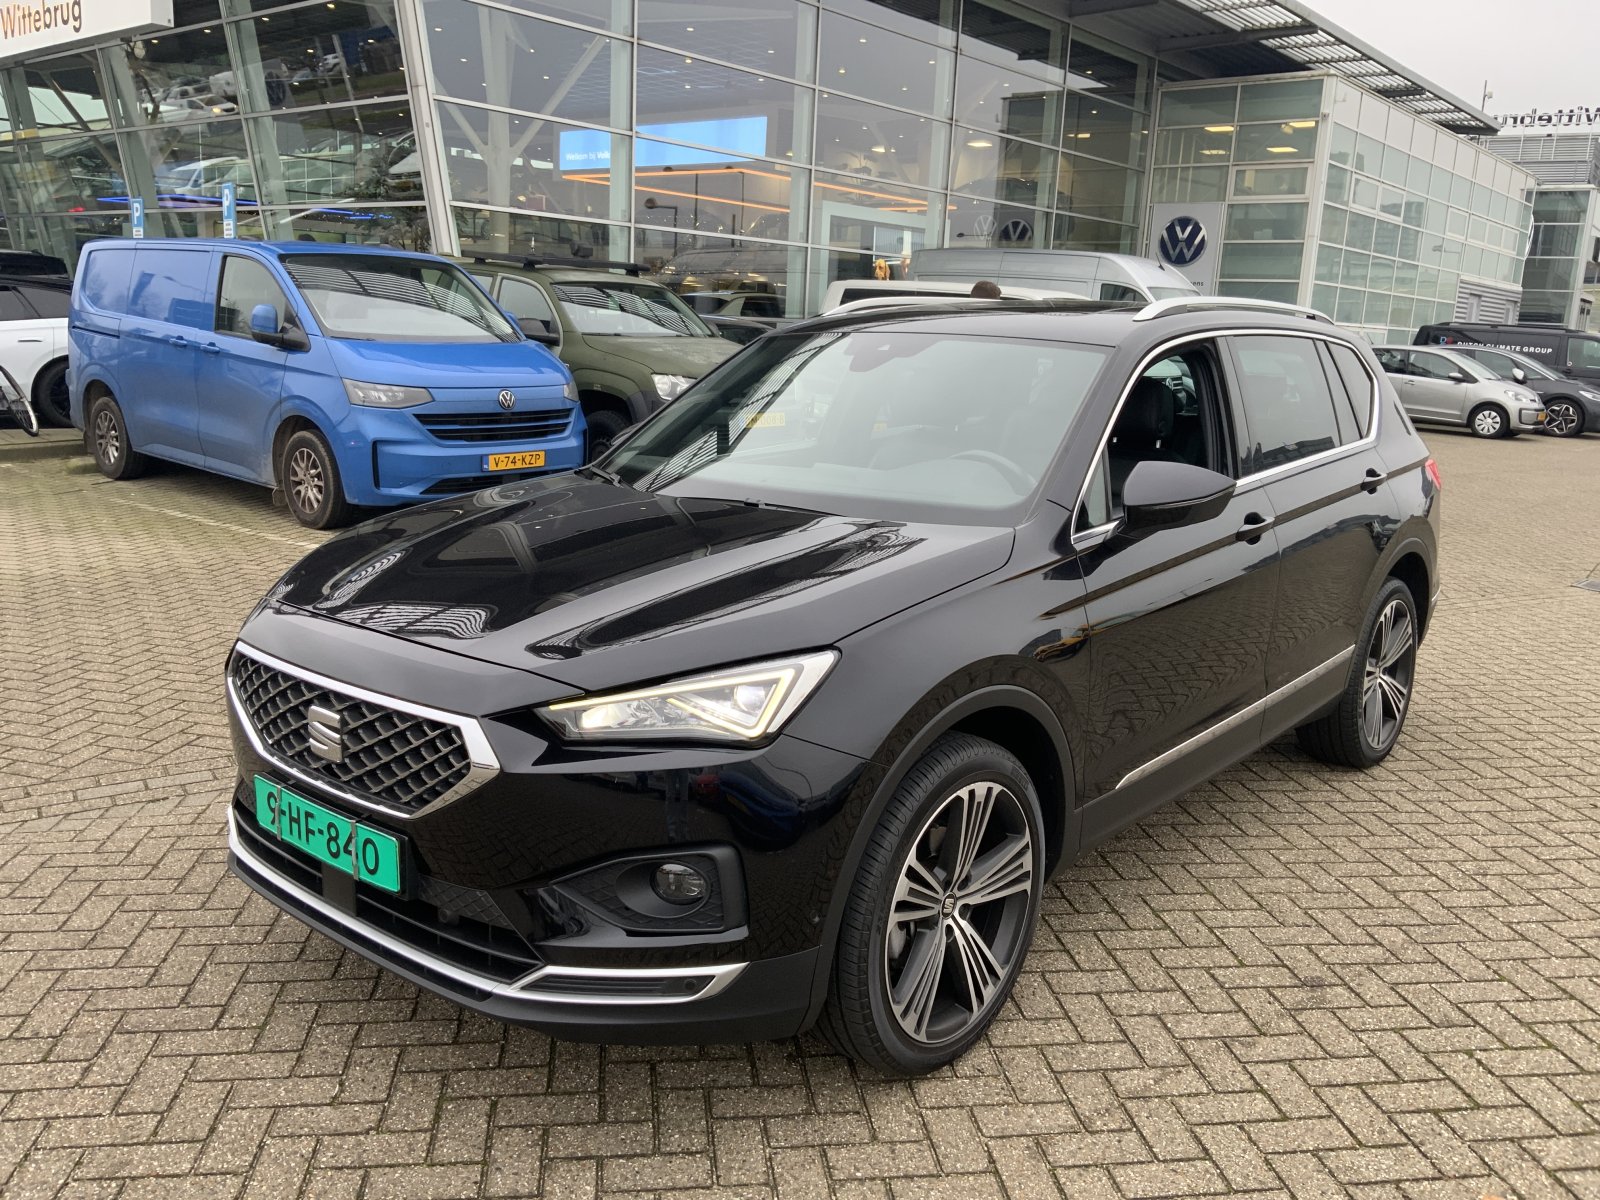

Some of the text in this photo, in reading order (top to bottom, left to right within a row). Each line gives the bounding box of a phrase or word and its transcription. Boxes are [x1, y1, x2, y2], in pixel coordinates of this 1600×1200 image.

[0, 0, 82, 39] Wittebrug
[566, 152, 588, 160] Welkom
[133, 202, 140, 224] P
[223, 188, 230, 216] P
[1523, 346, 1553, 354] GROUP
[493, 453, 541, 468] V-74-KZP
[266, 791, 380, 876] 9-HF-840
